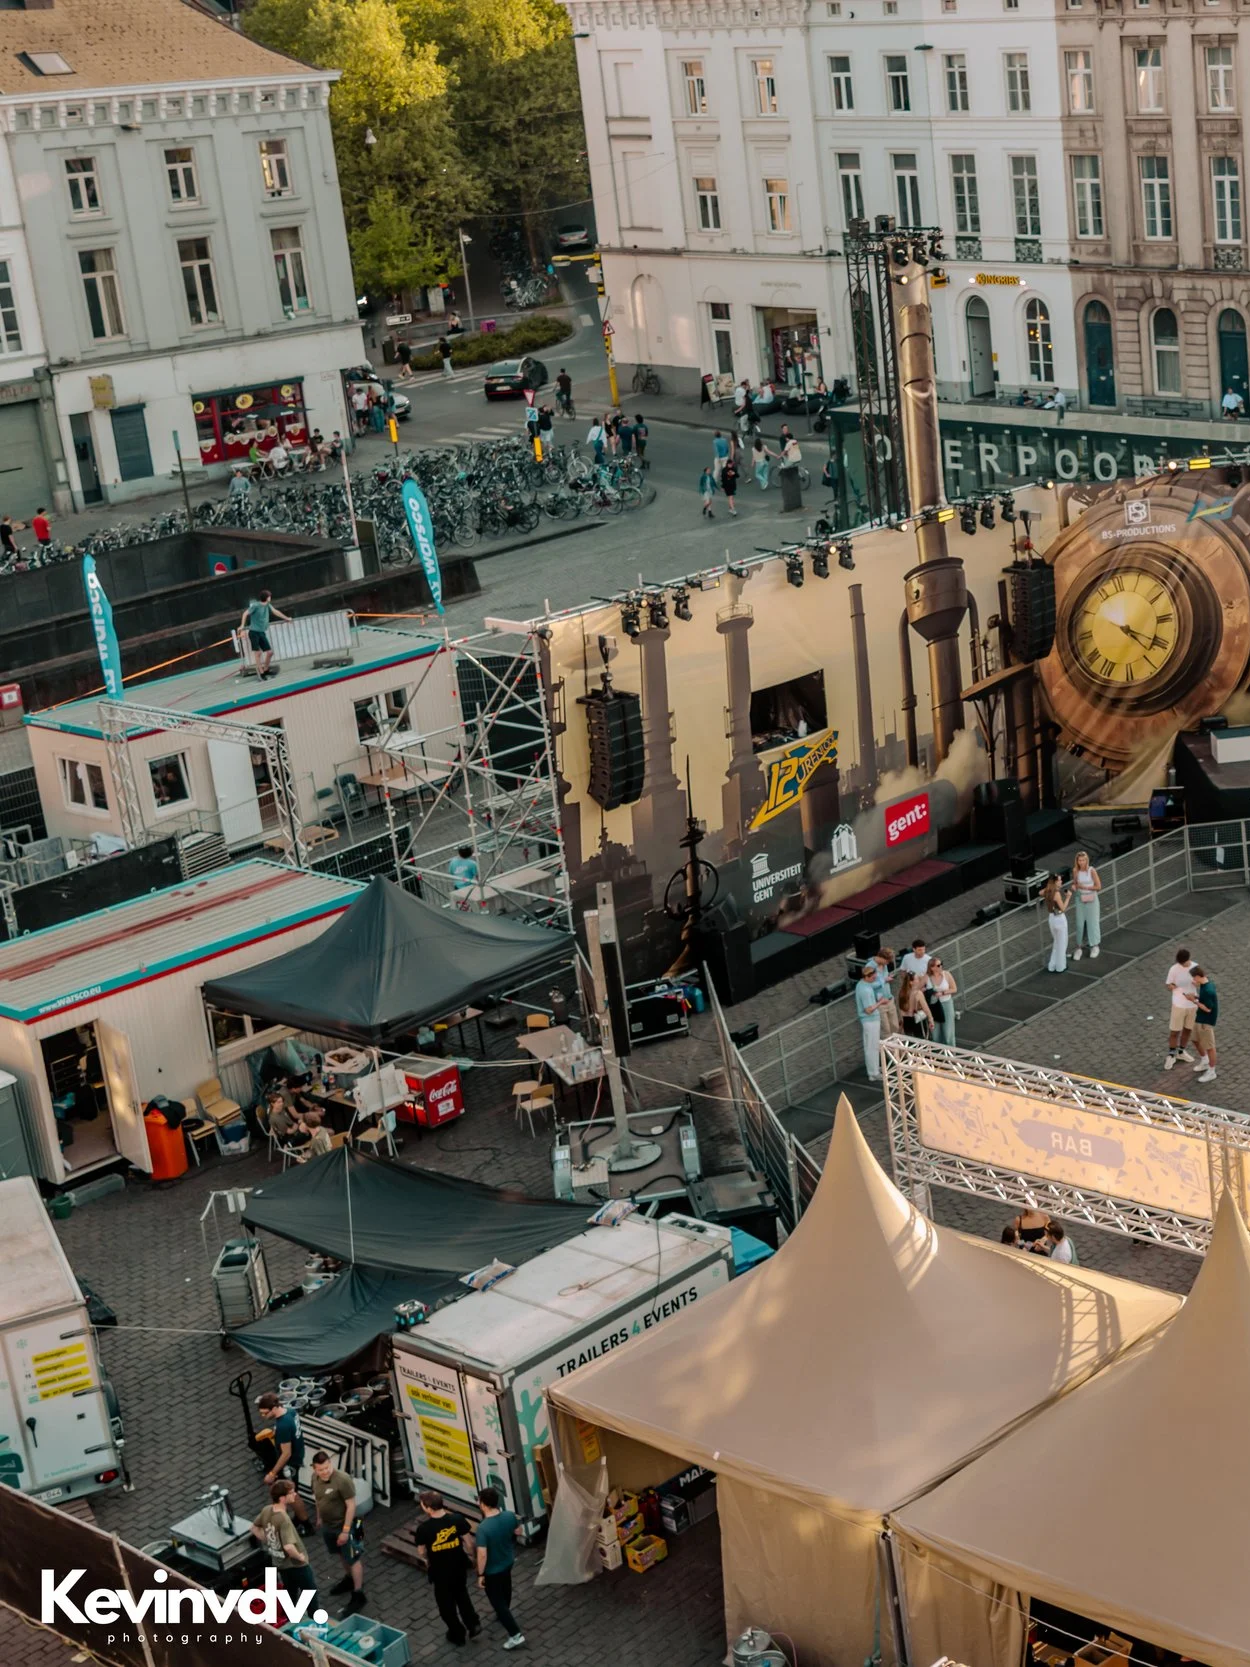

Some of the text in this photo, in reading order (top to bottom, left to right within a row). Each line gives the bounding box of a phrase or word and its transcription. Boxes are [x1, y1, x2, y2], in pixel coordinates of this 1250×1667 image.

[1101, 523, 1177, 540] BS-PRODUCTIONS
[766, 755, 800, 812] 12
[752, 863, 802, 892] UNIVERSITEIT
[753, 886, 774, 904] GENT
[556, 1286, 699, 1378] TRAILERS 4 EVENTS
[399, 1366, 456, 1392] TRAILERS EVENTS
